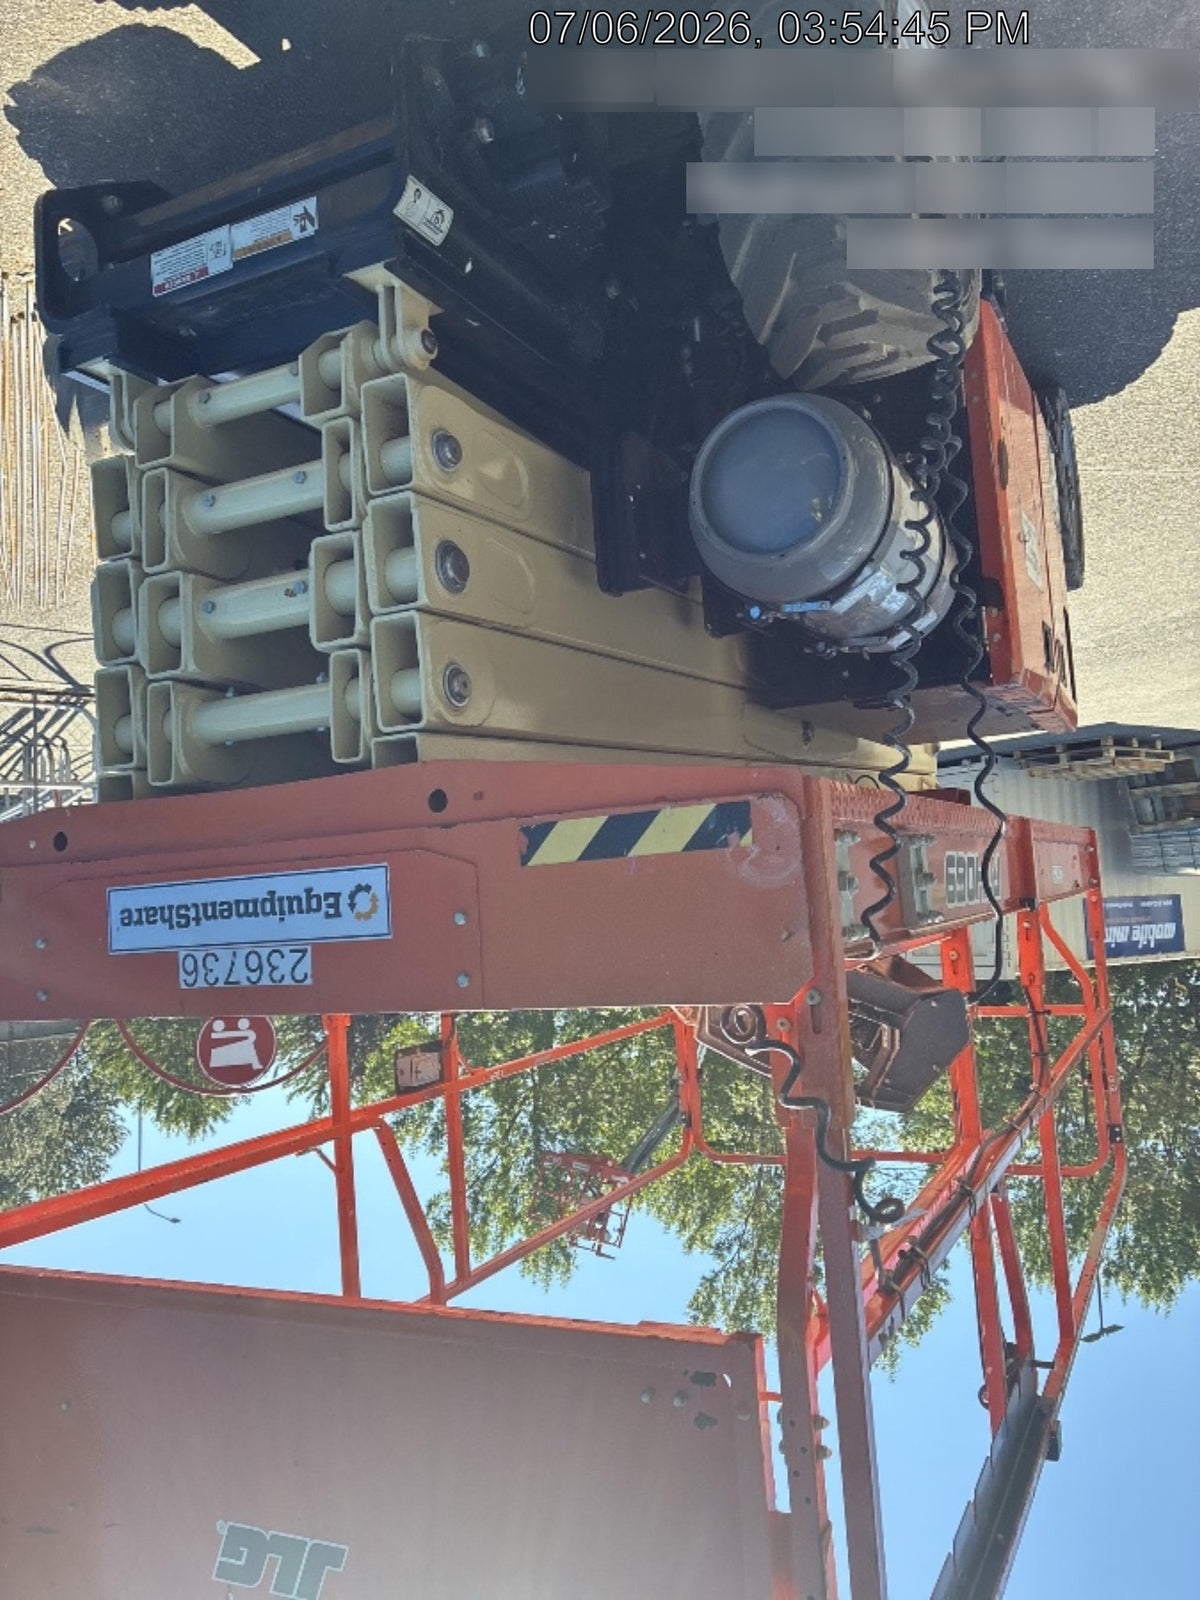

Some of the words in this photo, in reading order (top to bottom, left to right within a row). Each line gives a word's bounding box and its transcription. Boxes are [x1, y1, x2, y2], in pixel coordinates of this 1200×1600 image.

[119, 888, 342, 930] EquipmentShare
[1103, 925, 1130, 948] min
[1132, 922, 1176, 949] mobile
[181, 948, 309, 987] 236736
[211, 1521, 349, 1600] JLG
